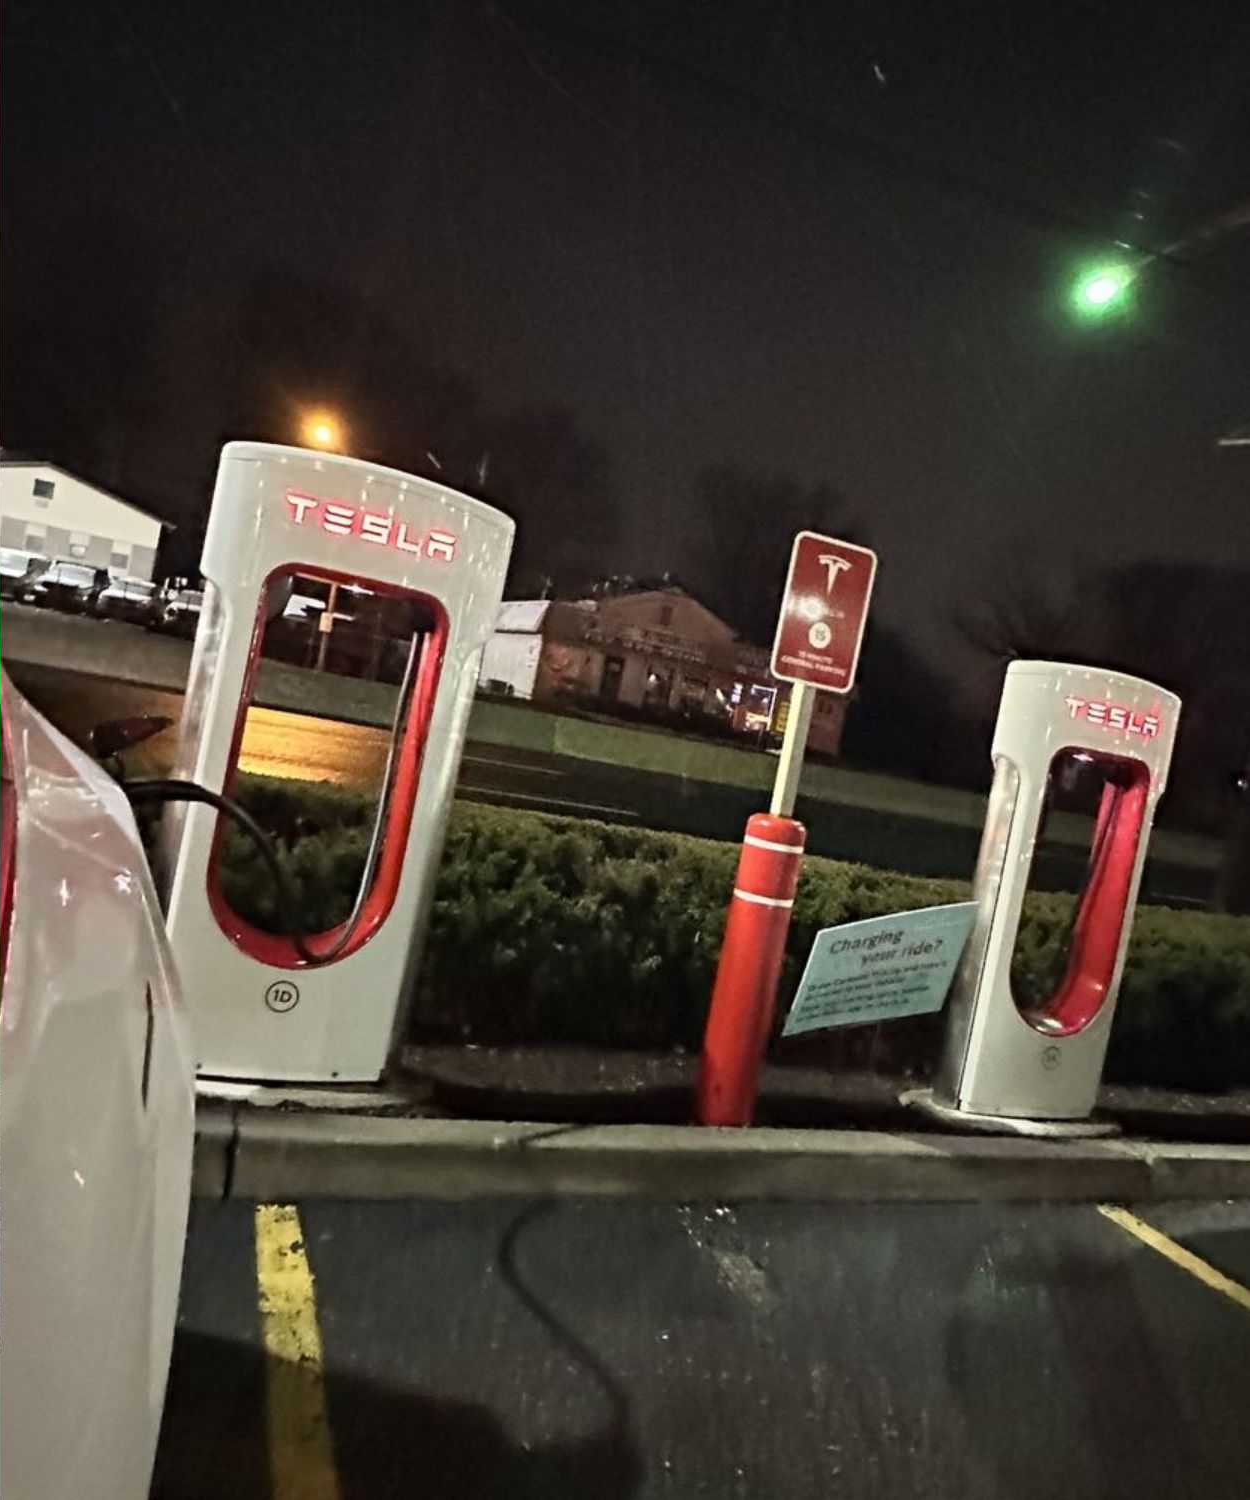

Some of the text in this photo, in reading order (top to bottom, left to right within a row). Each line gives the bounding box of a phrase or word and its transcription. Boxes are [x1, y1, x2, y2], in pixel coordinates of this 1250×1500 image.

[286, 494, 456, 562] TESLA
[1065, 698, 1159, 737] TESLA
[829, 929, 904, 955] Charging
[860, 939, 943, 967] your ride?
[274, 989, 293, 1003] 1D
